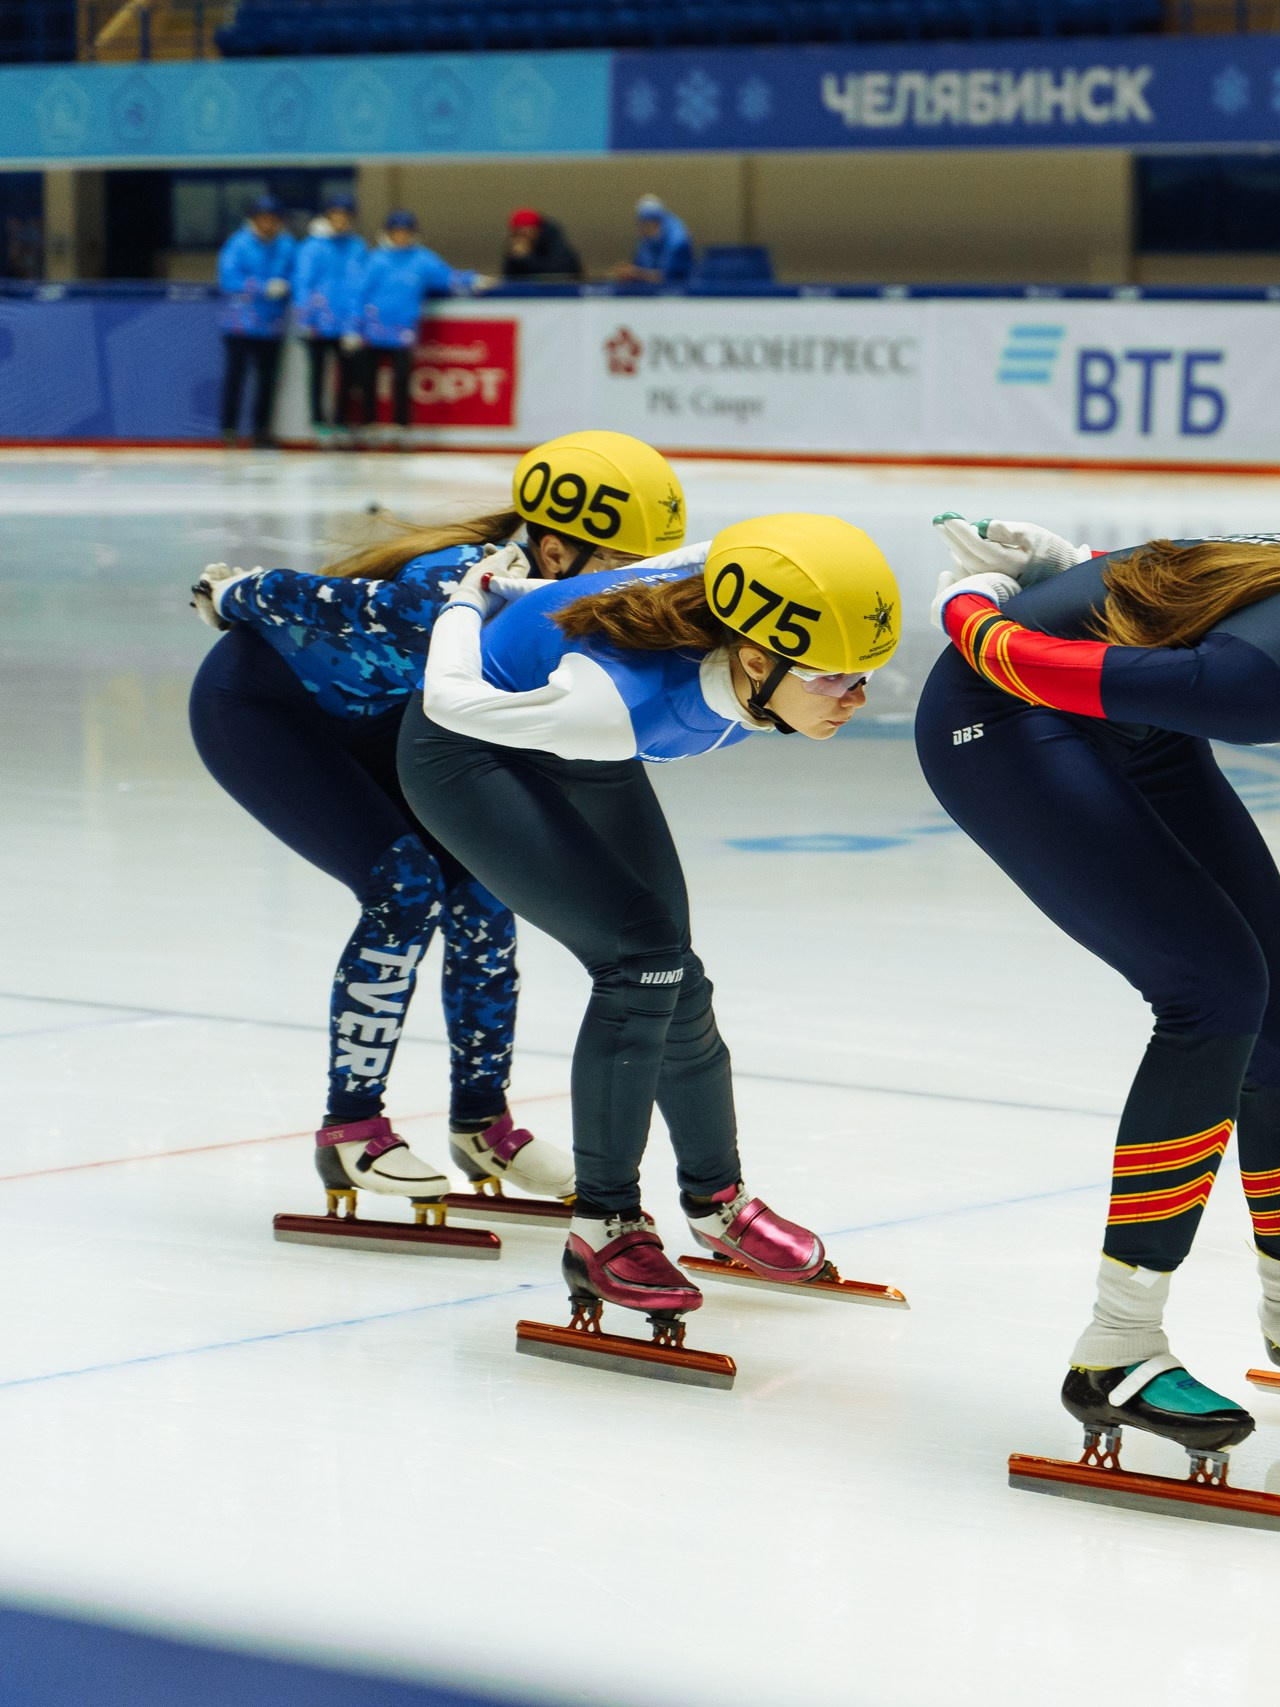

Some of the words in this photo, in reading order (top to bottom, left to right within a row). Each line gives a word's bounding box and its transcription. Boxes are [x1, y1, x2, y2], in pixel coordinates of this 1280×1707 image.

[820, 64, 1155, 128] ЧЕЛЯБИНСК
[647, 333, 918, 376] РОСКОНГРЕСС
[1075, 347, 1229, 437] ВТБ
[519, 461, 631, 540] 095
[713, 562, 822, 657] 075
[335, 943, 422, 1078] TVER
